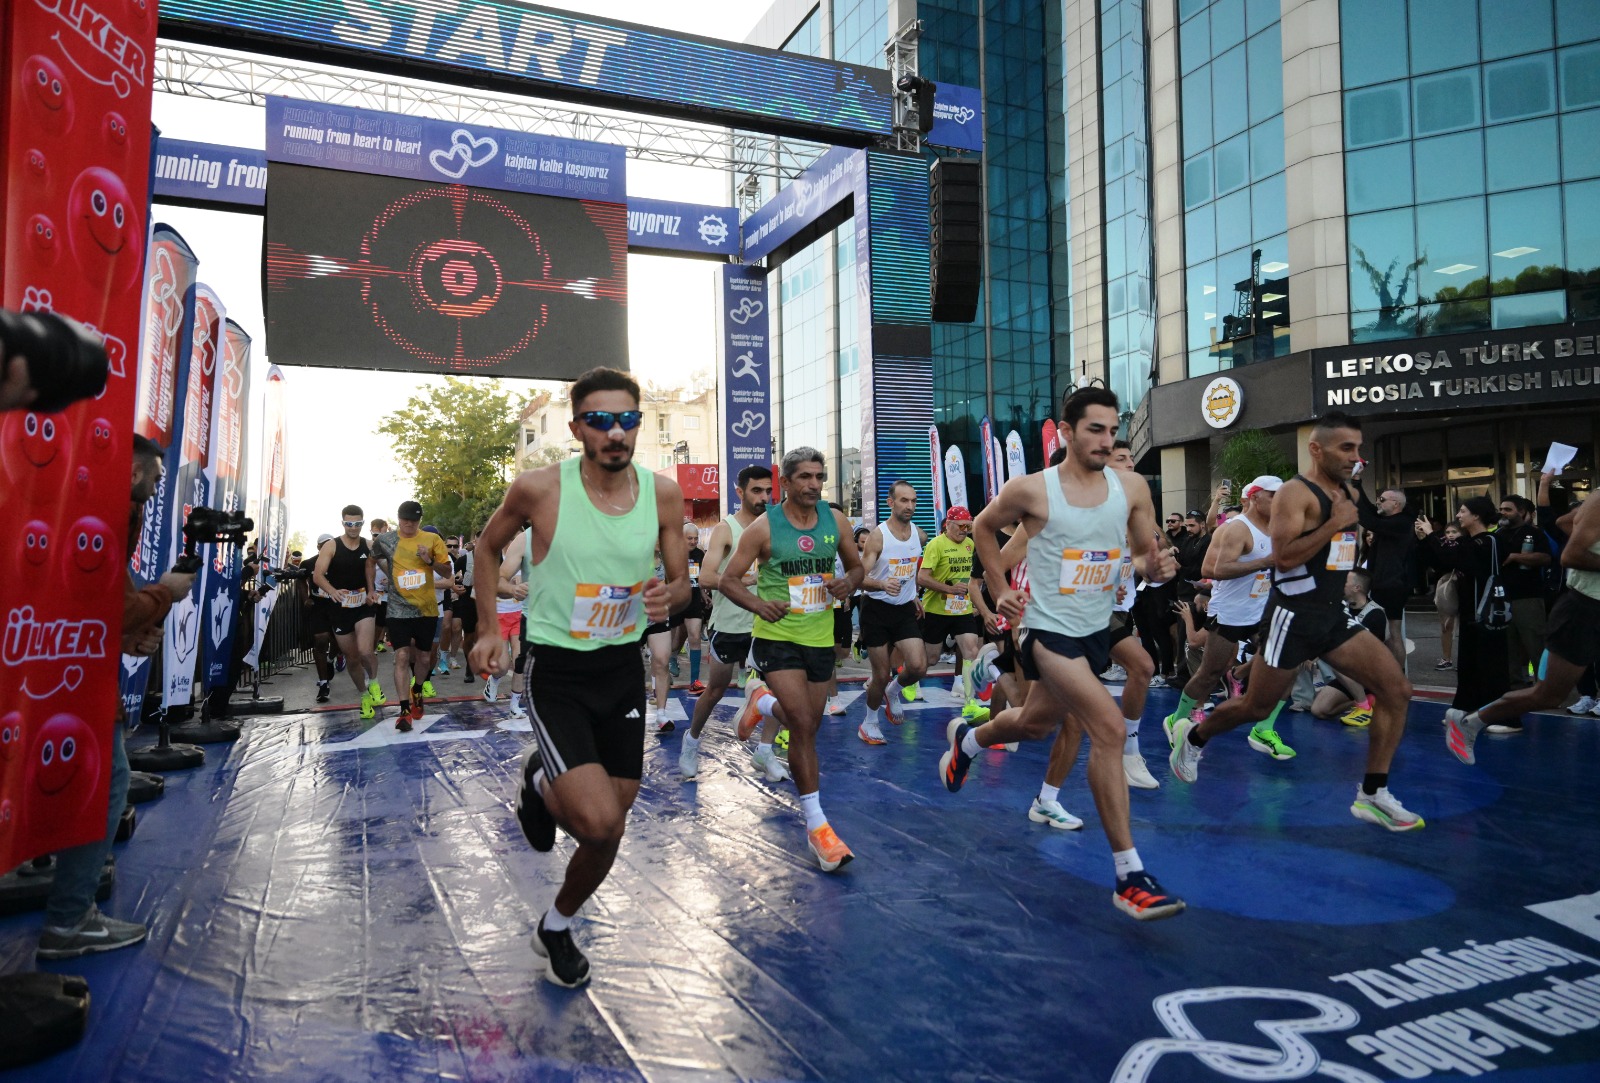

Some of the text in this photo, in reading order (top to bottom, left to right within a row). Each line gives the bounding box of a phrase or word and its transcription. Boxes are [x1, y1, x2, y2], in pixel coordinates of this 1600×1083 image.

[33, 0, 146, 87] LKER
[331, 0, 628, 85] START
[283, 124, 422, 155] running from heart to heart
[504, 153, 610, 179] kalpten kalbe koşuyoruz
[156, 155, 222, 190] unning
[1326, 334, 1600, 379] LEFKOŞA TÜRK BE
[155, 348, 173, 433] koşuyoruz
[1326, 381, 1424, 407] NICOSIA
[1429, 371, 1542, 398] TURKISH
[141, 494, 157, 580] LEFKO
[153, 464, 167, 561] MARATONU
[780, 557, 814, 577] MANİSA
[1072, 564, 1112, 585] 21153
[3, 604, 107, 665] ÜLKER
[1346, 1007, 1554, 1080] kalbe
